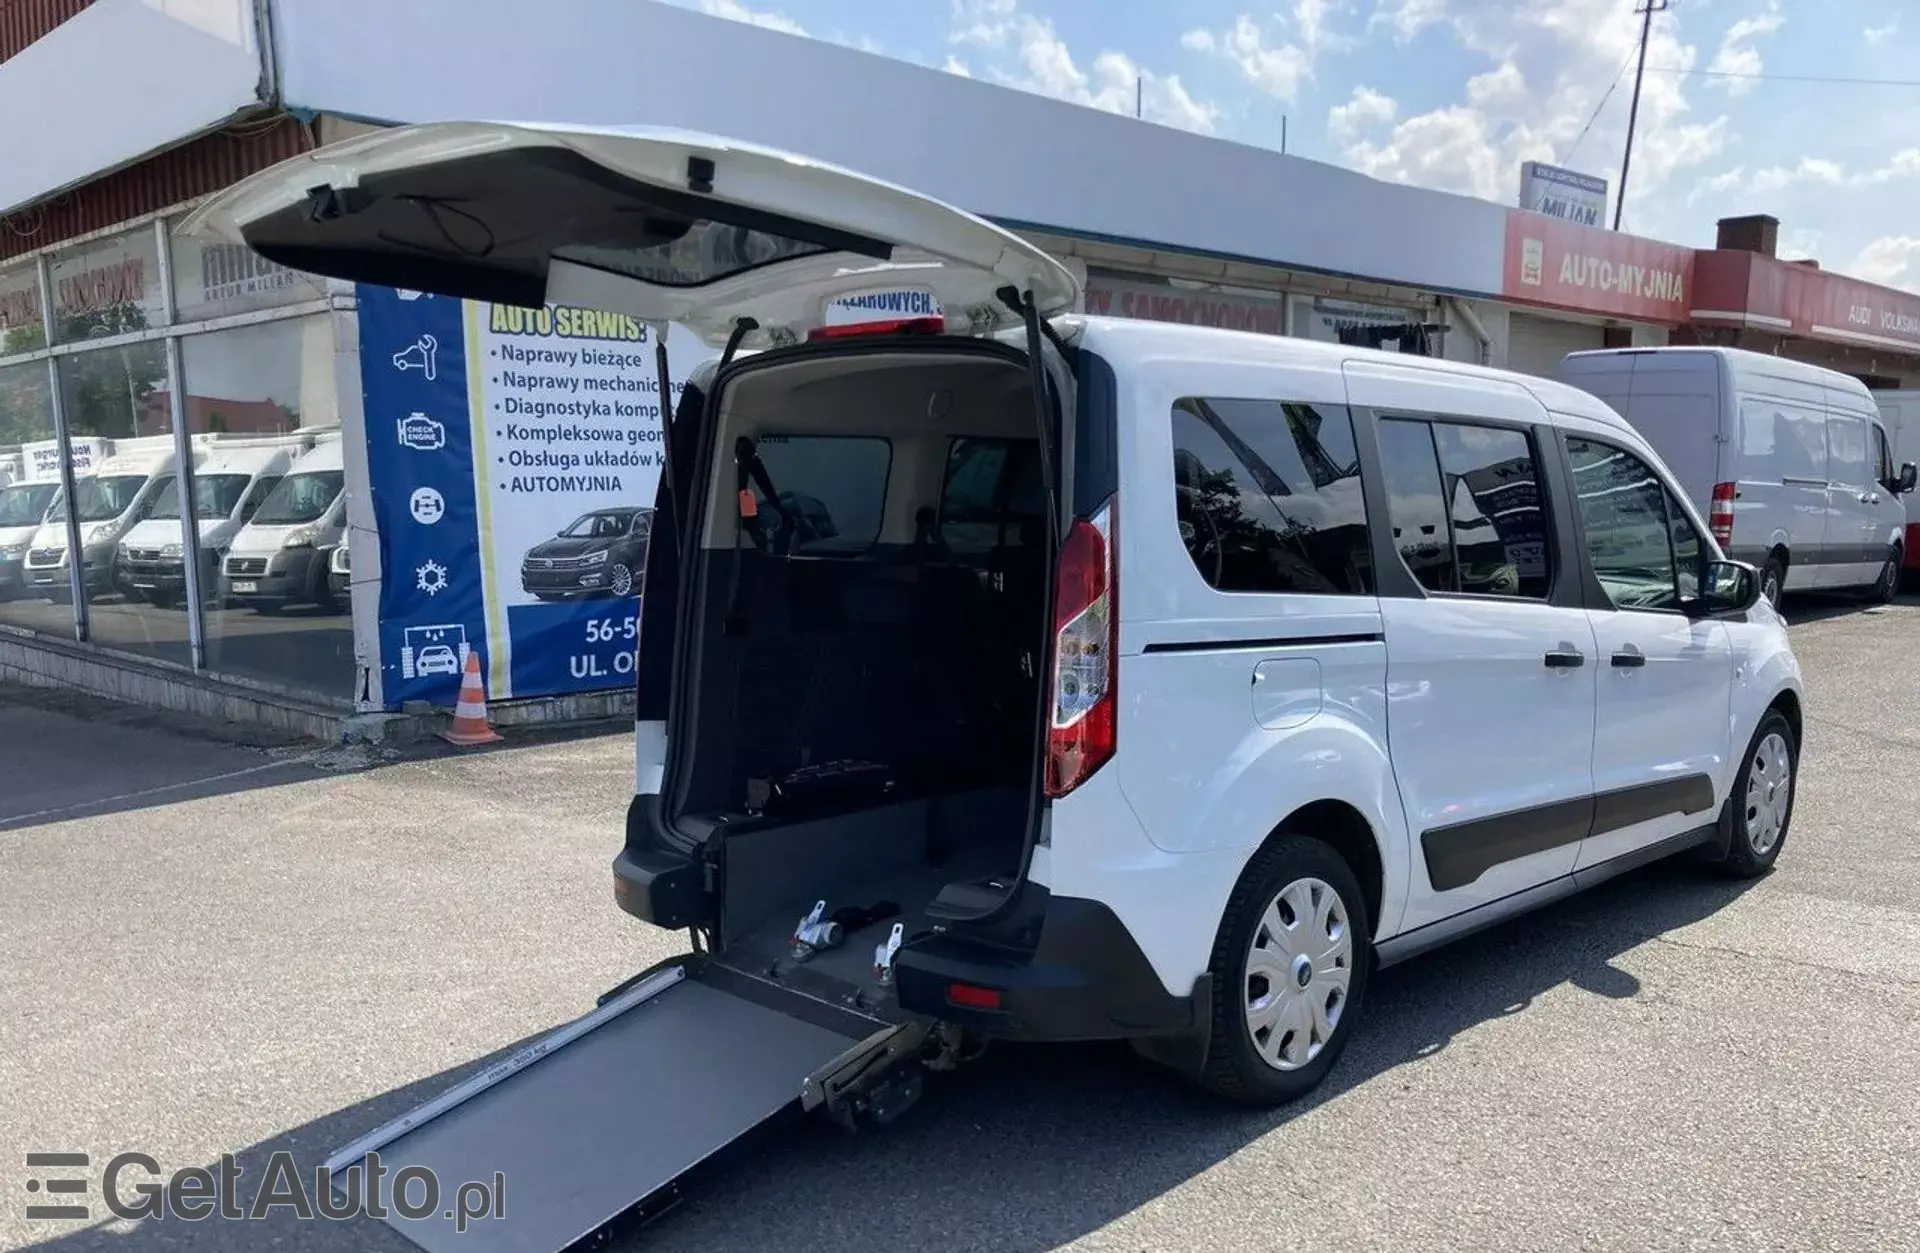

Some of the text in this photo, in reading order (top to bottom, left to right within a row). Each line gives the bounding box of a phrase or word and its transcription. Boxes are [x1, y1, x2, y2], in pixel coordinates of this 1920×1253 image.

[1558, 253, 1684, 303] AUTO-MYJNIA
[490, 302, 647, 342] AUTO SERWIS:
[501, 344, 642, 370] Naprawy bieżące
[502, 370, 684, 394] Naprawy mechanicne
[505, 396, 661, 421] Diagnostyka komp
[506, 423, 624, 445] Kompleksowa
[508, 449, 580, 471] Obsługa
[584, 450, 651, 467] układów
[510, 475, 623, 494] AUTOMYJNIA
[569, 654, 608, 679] UL.
